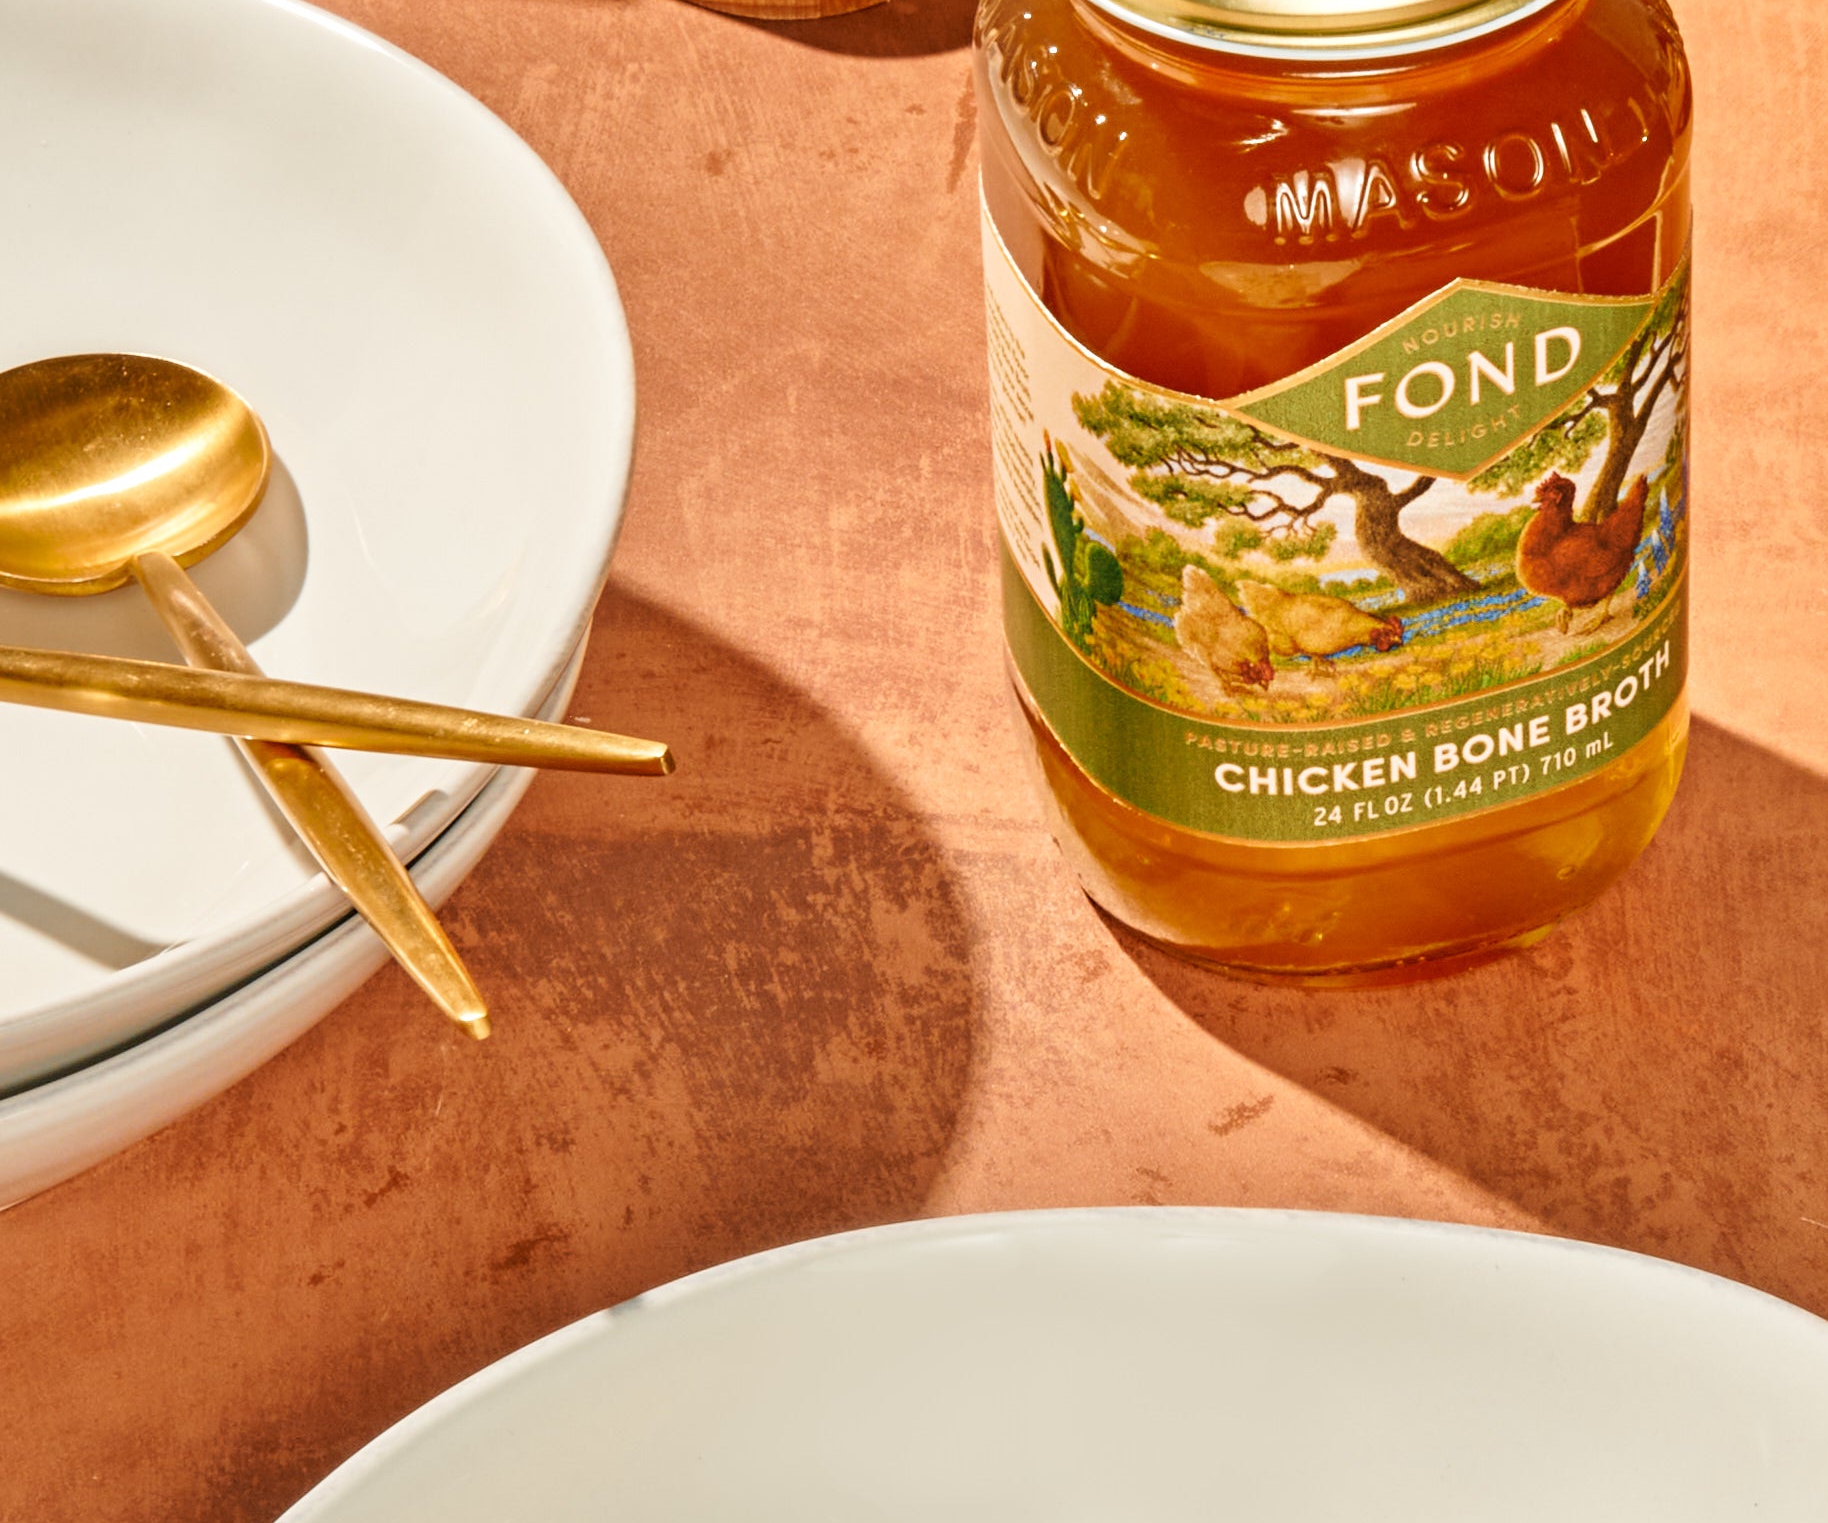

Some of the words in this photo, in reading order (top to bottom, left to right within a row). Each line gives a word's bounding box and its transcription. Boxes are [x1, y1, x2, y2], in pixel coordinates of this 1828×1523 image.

[1273, 106, 1602, 242] MASON
[1344, 326, 1582, 431] FOND
[1402, 313, 1523, 355] NOURISH
[1406, 403, 1522, 449] DELIGHT
[1184, 732, 1393, 760] PASTURE-RAISED
[1401, 728, 1416, 743] &
[1214, 750, 1417, 797] CHICKEN
[1433, 715, 1550, 774] BONE
[1565, 639, 1670, 736] BROTH
[1313, 805, 1343, 827] 24
[1424, 779, 1483, 809] (1.44
[1492, 763, 1530, 791] PT)
[1540, 747, 1577, 776] 710
[1585, 731, 1614, 759] mL
